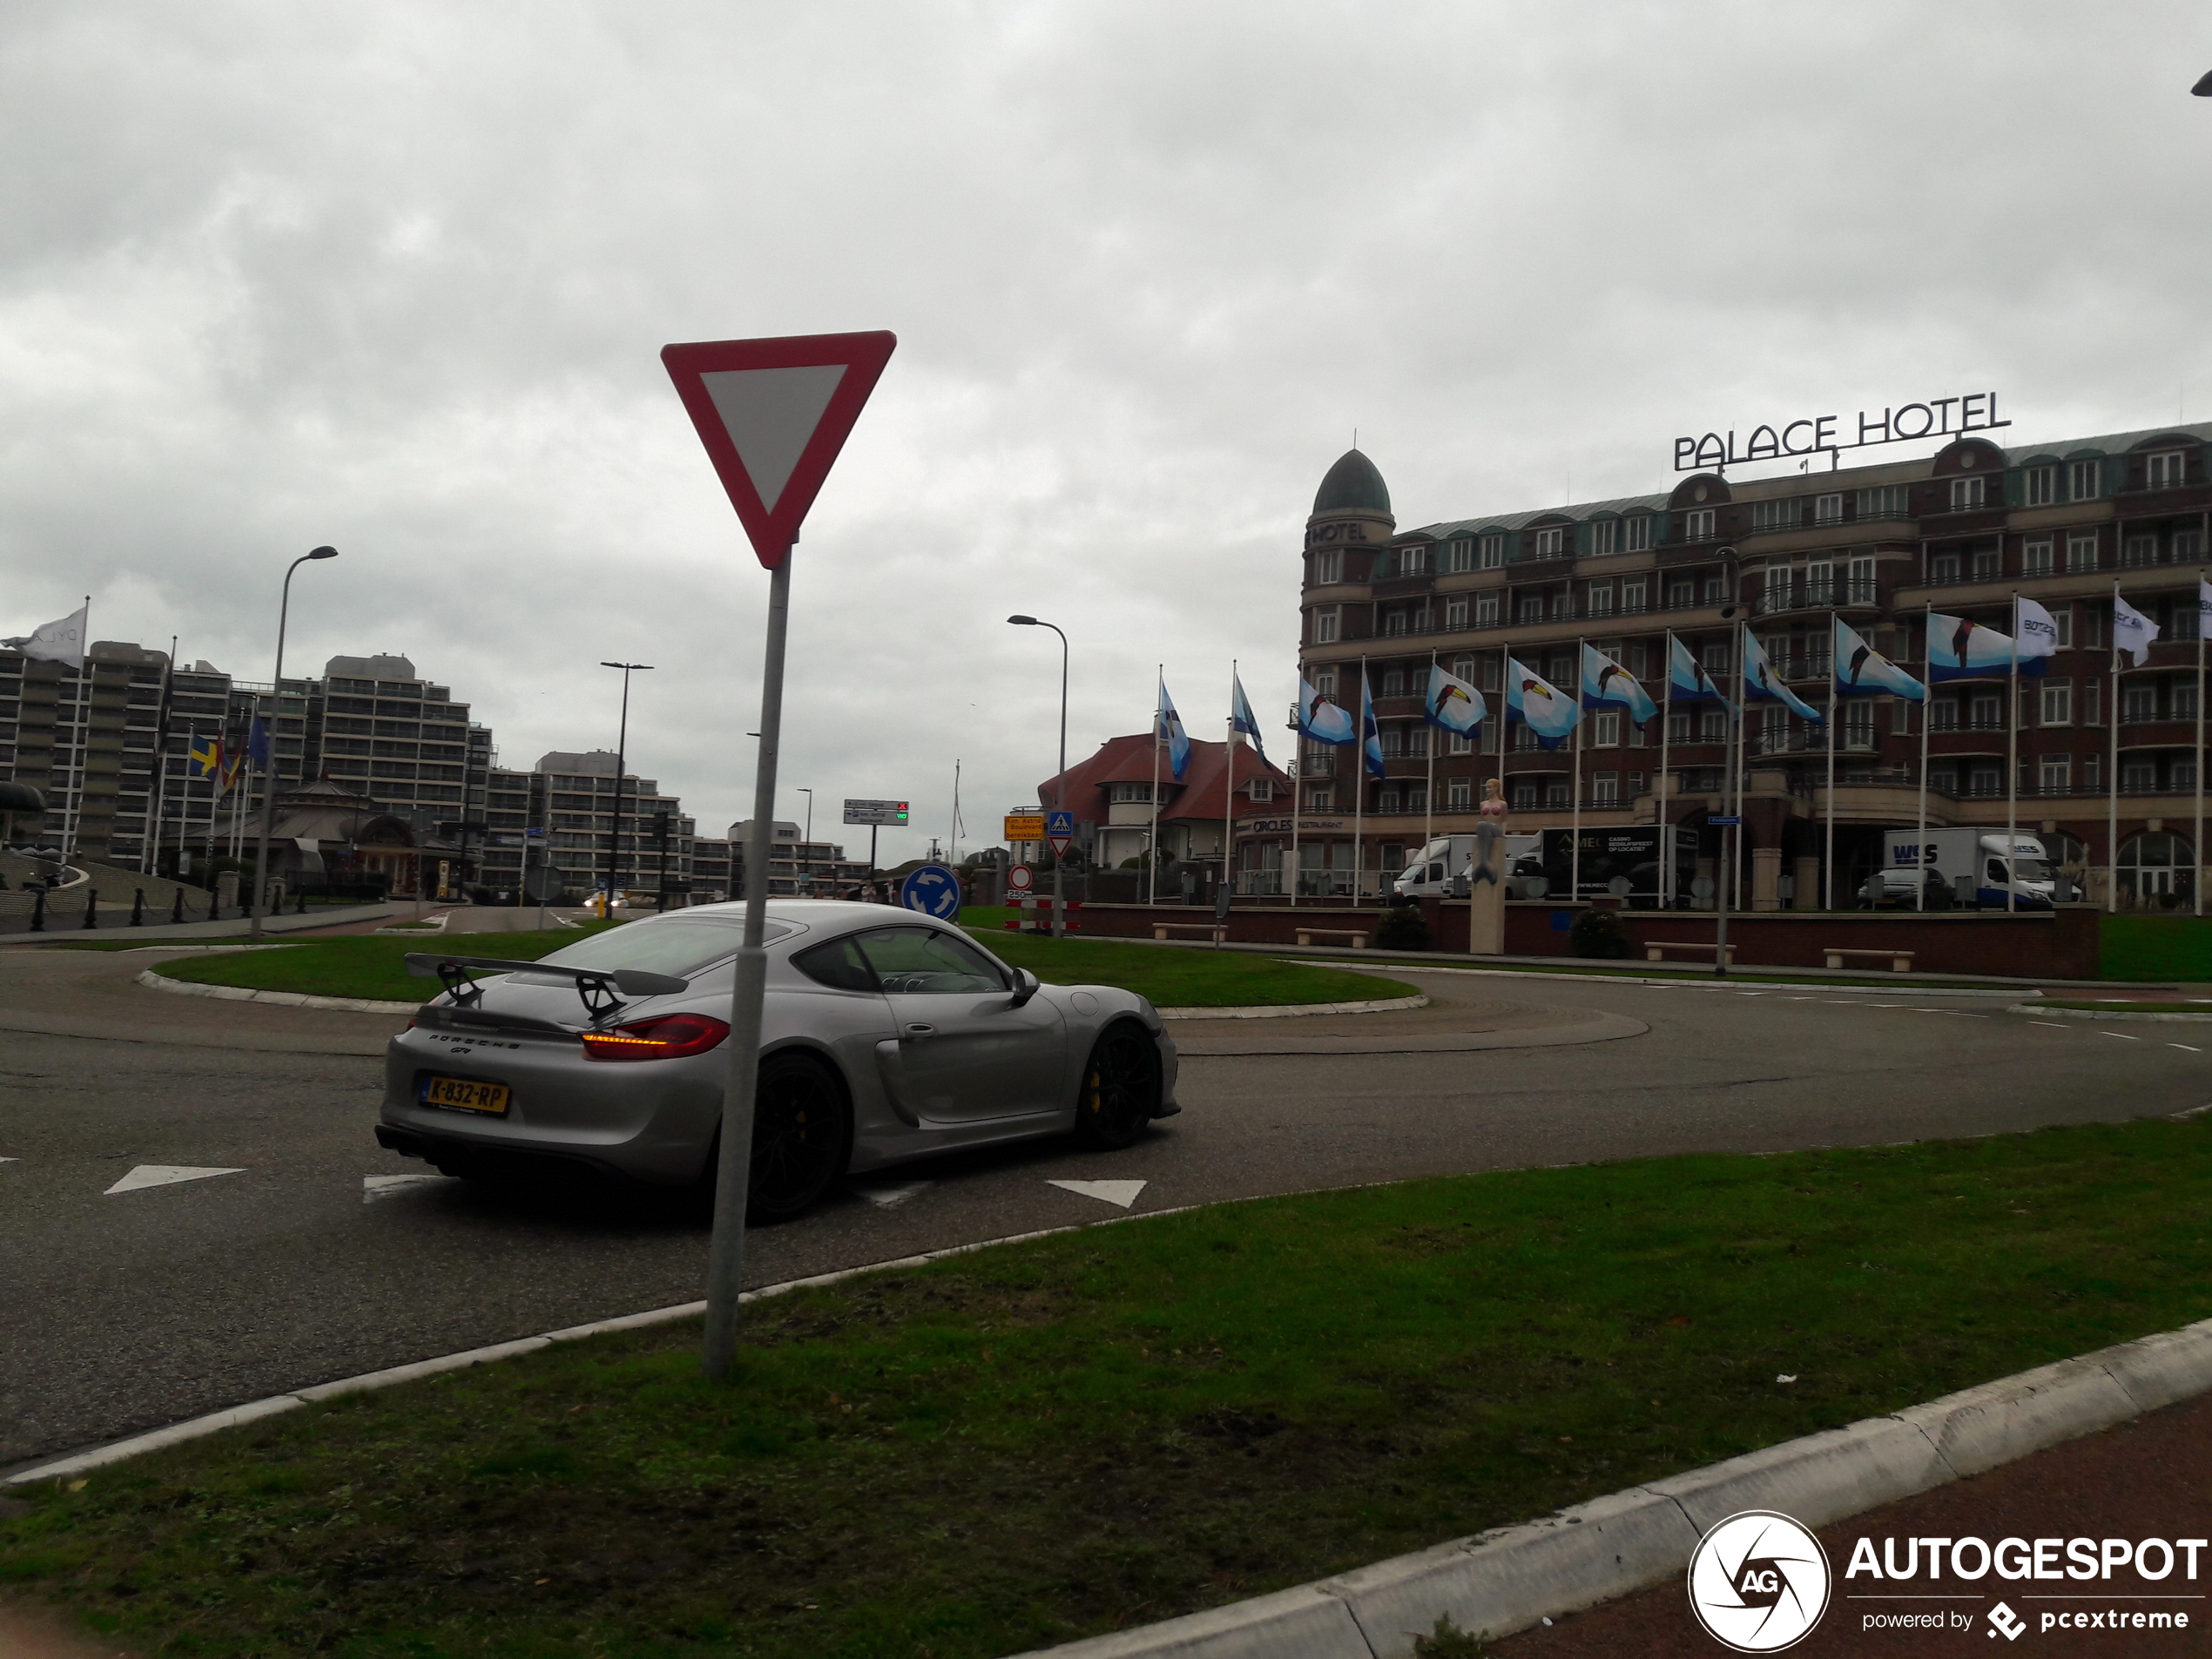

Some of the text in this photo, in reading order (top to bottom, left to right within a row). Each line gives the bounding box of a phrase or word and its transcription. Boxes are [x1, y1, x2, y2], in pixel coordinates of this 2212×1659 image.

[1675, 392, 2013, 471] PALACE HOTEL
[429, 1035, 520, 1049] PORSCHE
[432, 1080, 502, 1106] K-832-RP
